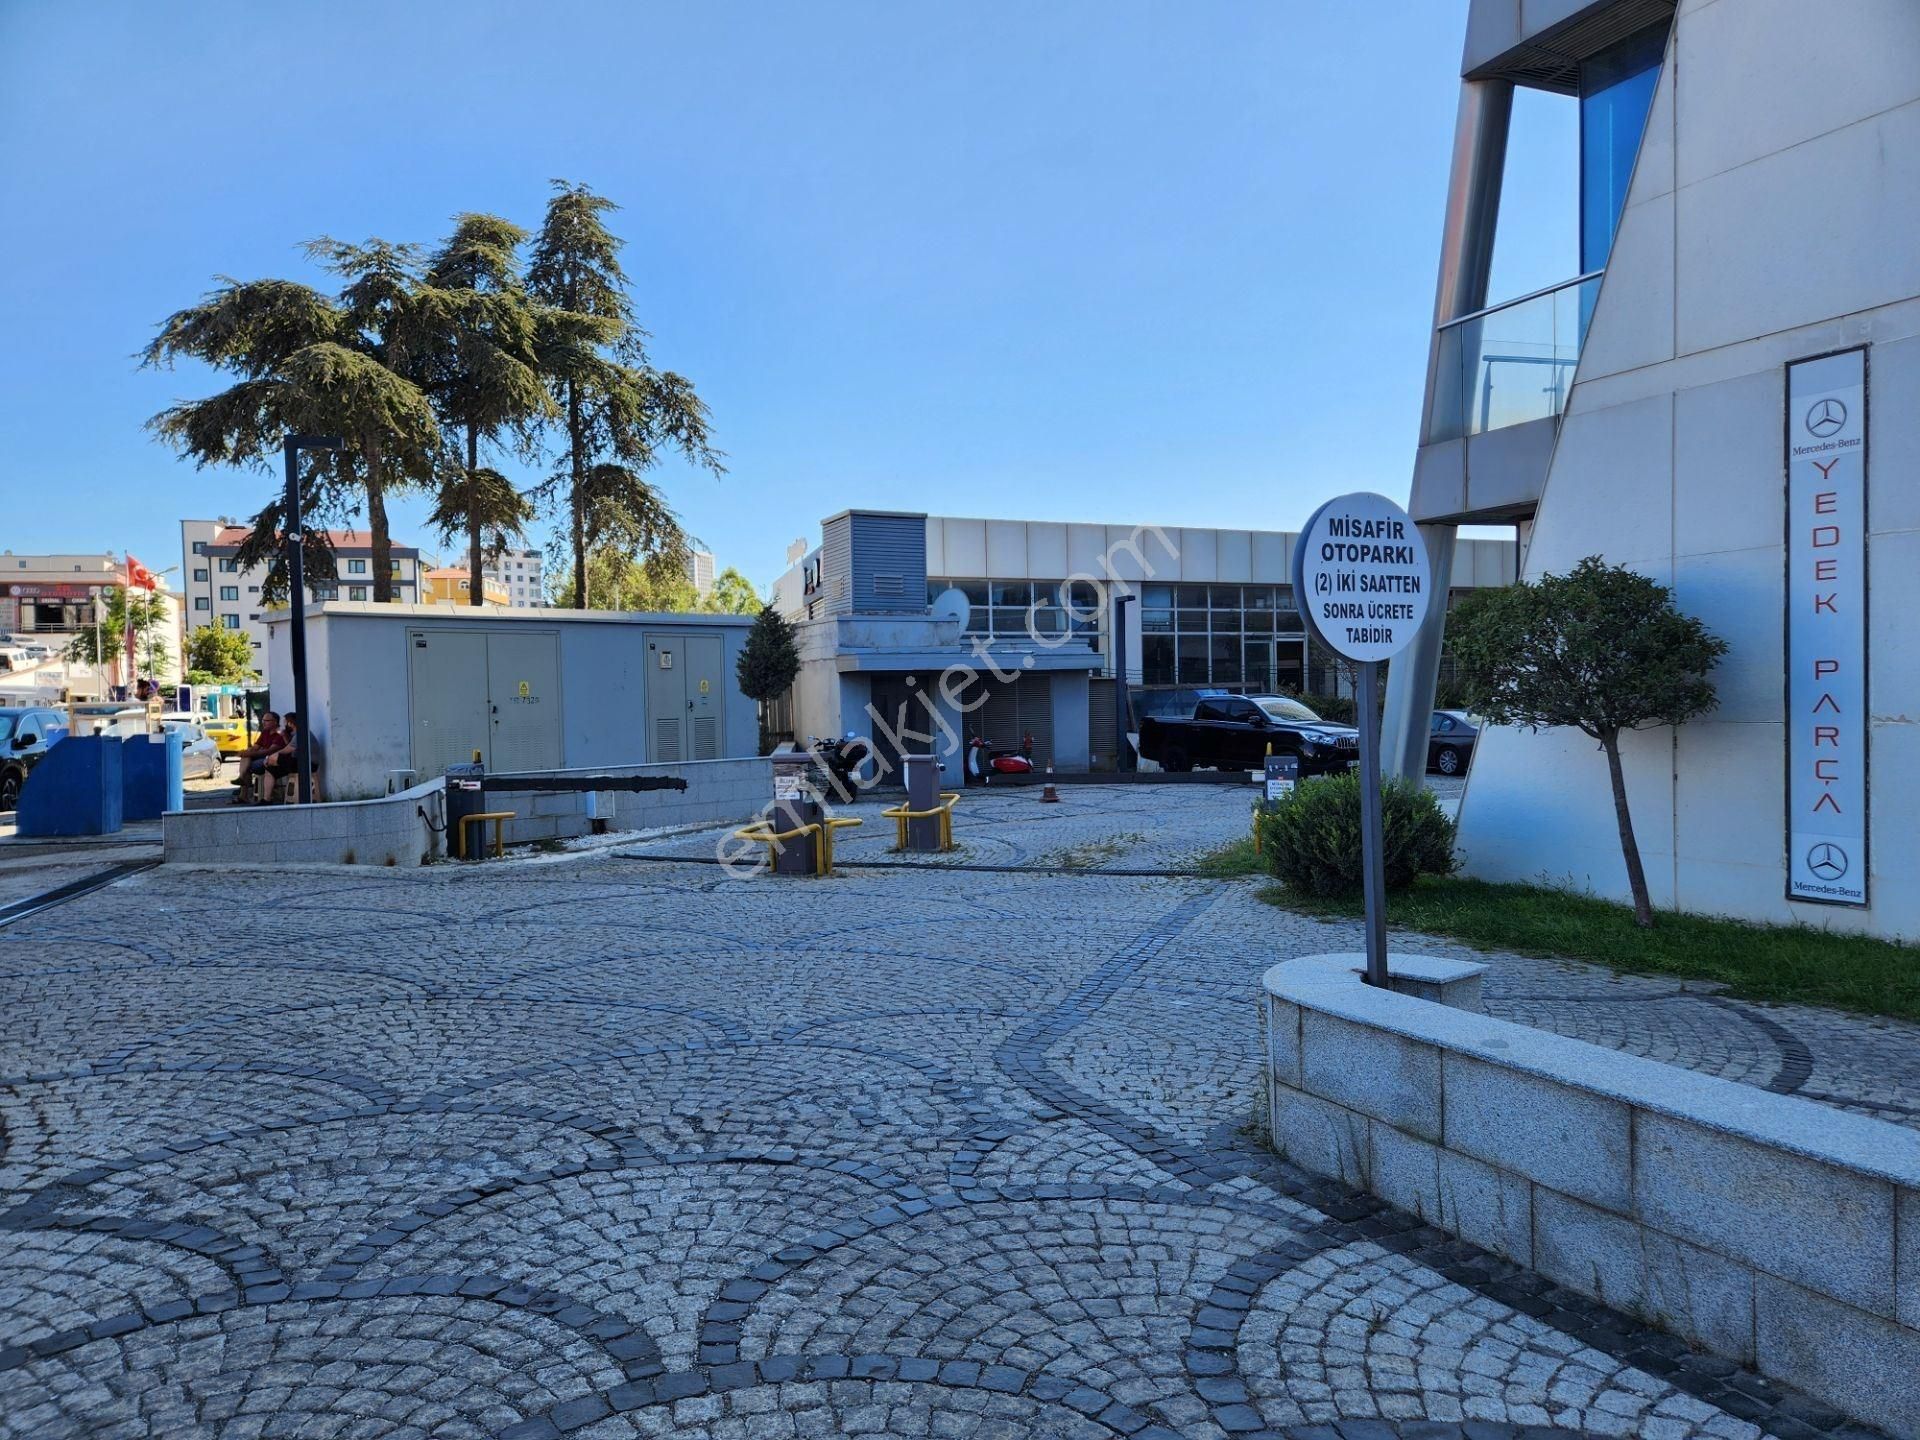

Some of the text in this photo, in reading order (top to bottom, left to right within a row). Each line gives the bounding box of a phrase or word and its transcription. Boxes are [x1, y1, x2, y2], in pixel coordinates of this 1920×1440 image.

[1792, 437, 1861, 456] Mercedes-Benz
[1329, 514, 1404, 540] MİSAFİR
[1321, 543, 1413, 564] OTOPARKI
[1315, 570, 1420, 596] (2) İKİ SAATTEN
[1323, 600, 1413, 619] SONRA ÜCRETE
[1346, 624, 1392, 643] TABİDİR
[1811, 457, 1841, 814] YEDEK PARÇA
[1793, 881, 1861, 898] Mercedes-Benz
